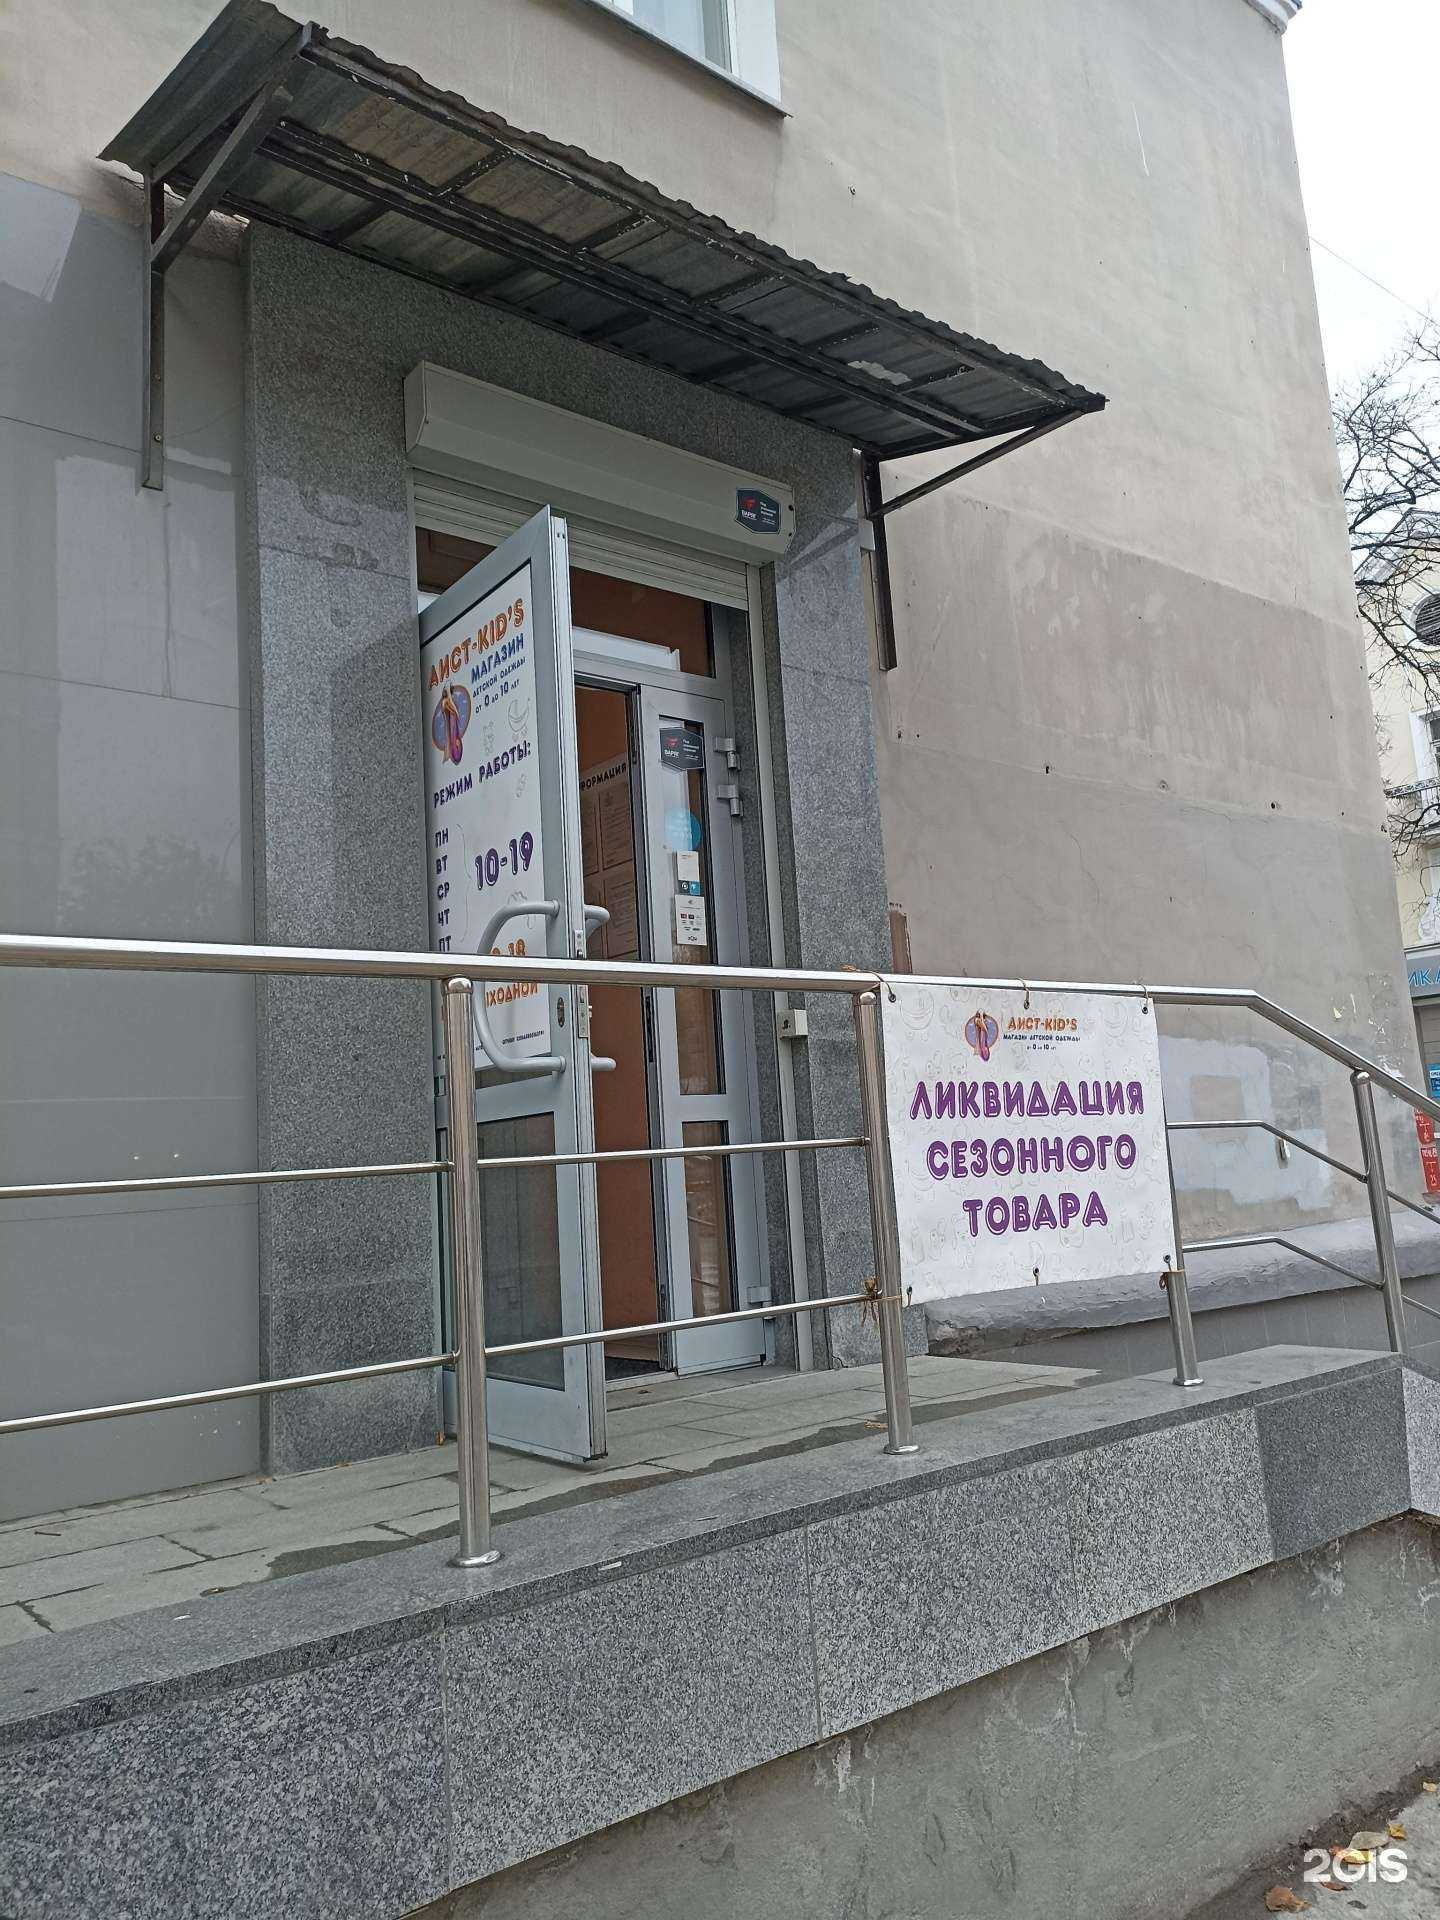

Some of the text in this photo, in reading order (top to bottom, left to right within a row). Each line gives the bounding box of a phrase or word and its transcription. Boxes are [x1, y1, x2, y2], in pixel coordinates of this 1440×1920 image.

[471, 632, 524, 684] МАГАЗИН
[500, 681, 509, 697] 10
[433, 740, 531, 809] РЕЖИМ РАБОТЫ:
[580, 762, 627, 791] ФОРМАЦИЯ
[435, 827, 449, 848] ПН
[435, 854, 448, 875] ВТ
[475, 831, 534, 891] 10-19
[437, 881, 450, 900] СР
[438, 908, 450, 927] ЧТ
[439, 935, 451, 952] ПТ
[485, 980, 539, 1009] ХОДНОЙ
[910, 1080, 1145, 1120] ЛИКВИДАЦИЯ
[927, 1133, 1137, 1180] СЕЗОННОГО
[963, 1191, 1108, 1237] ТОВАРА
